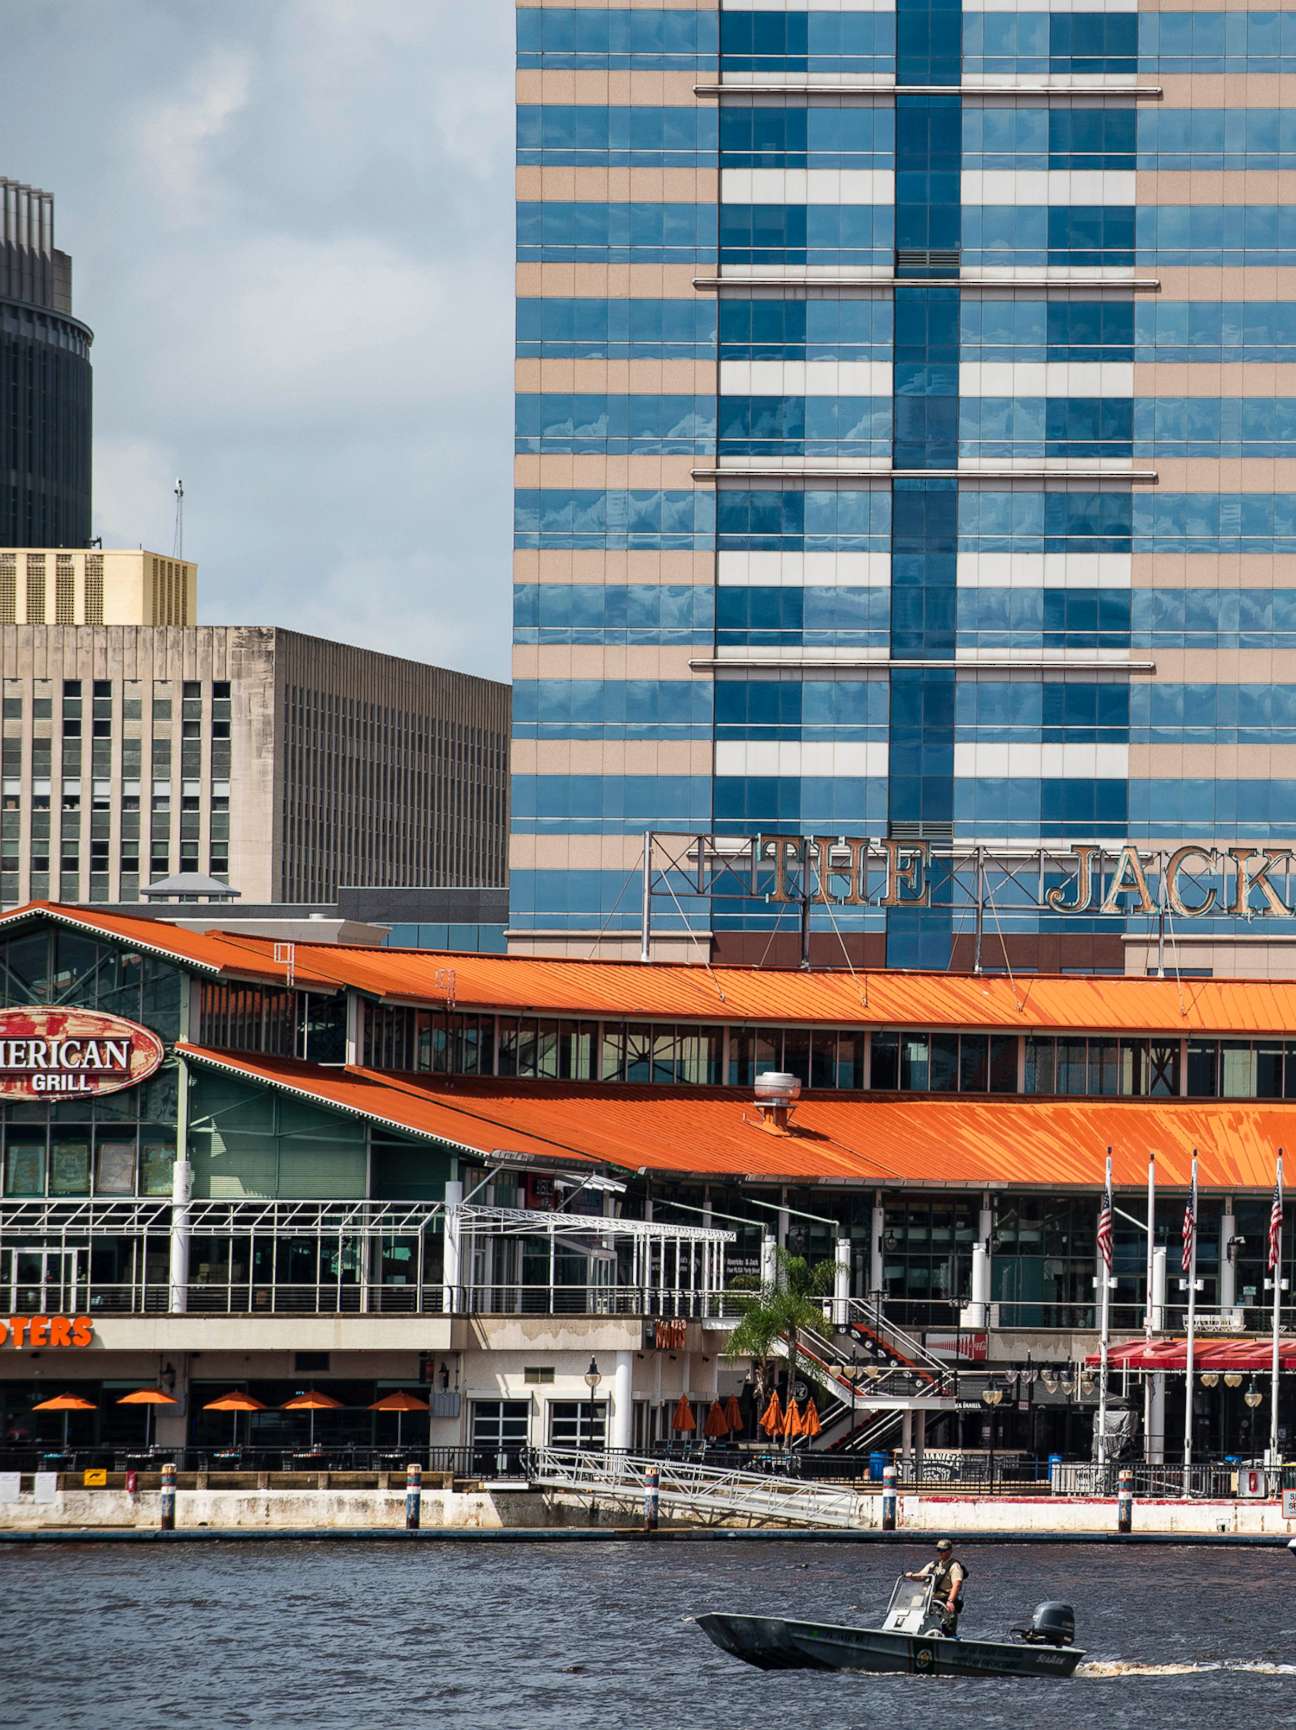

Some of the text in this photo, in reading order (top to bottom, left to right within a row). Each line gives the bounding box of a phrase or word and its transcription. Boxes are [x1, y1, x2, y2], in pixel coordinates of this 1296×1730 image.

[757, 833, 931, 908] THE
[0, 1040, 130, 1069] ERICAN
[32, 1074, 91, 1091] GRILL
